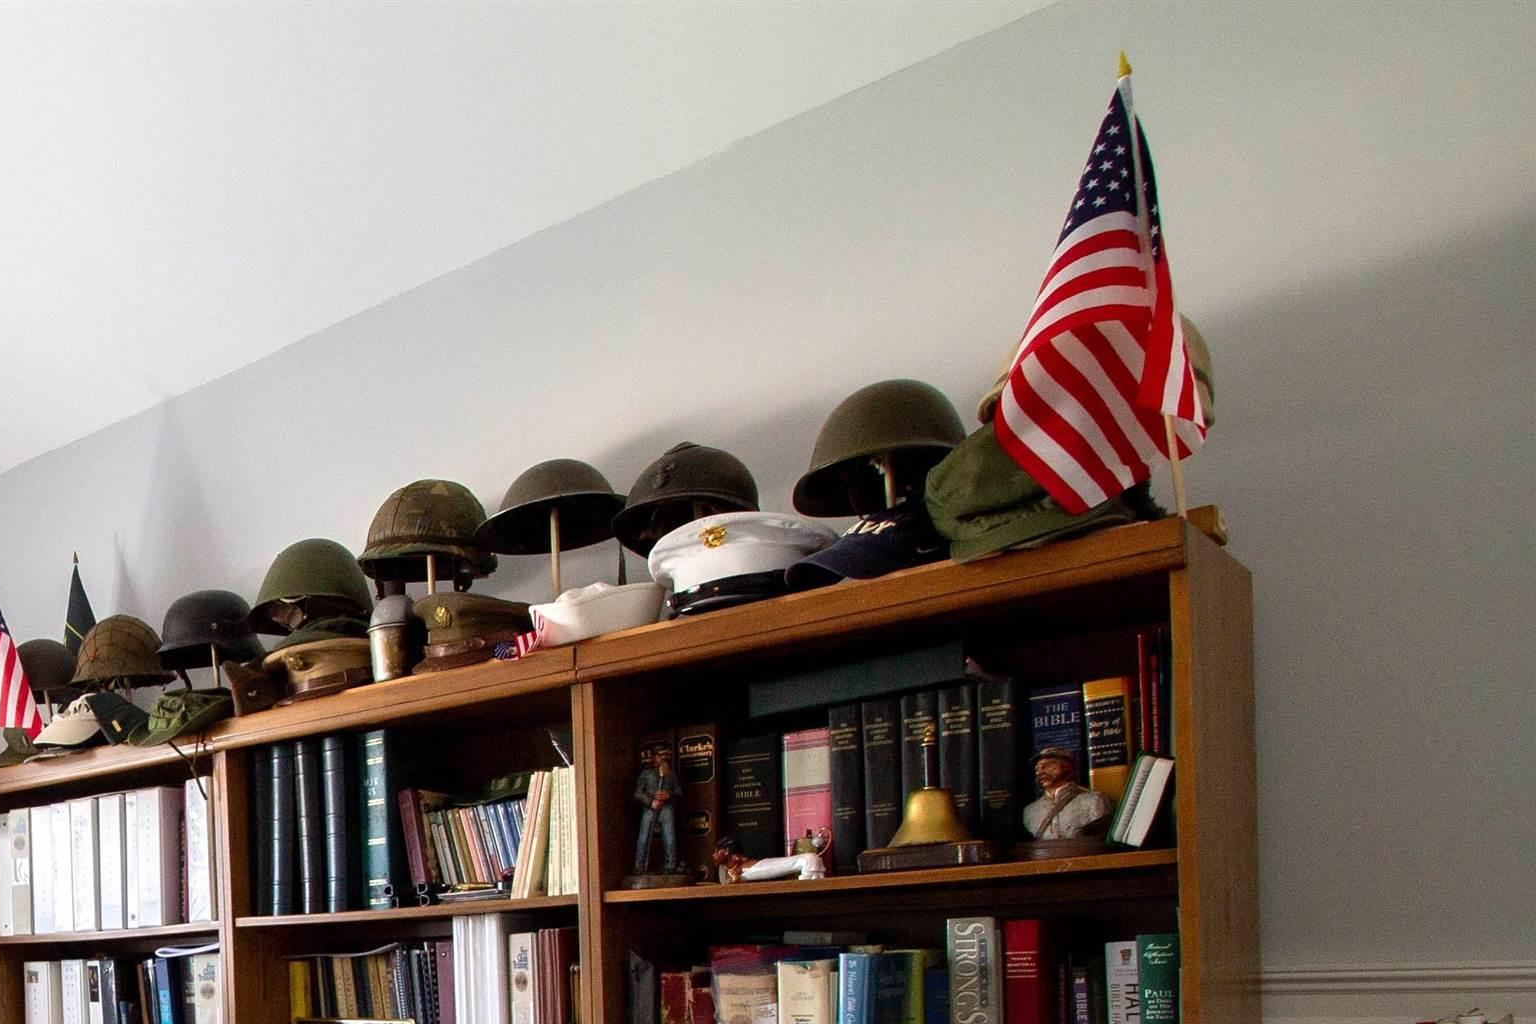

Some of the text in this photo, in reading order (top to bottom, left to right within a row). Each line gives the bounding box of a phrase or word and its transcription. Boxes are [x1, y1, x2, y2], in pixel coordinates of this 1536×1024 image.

[1044, 702, 1069, 714] THE
[1034, 711, 1081, 728] BIBLE
[735, 790, 761, 799] BIBLE
[954, 922, 987, 1024] STRONG'S
[1110, 983, 1121, 1009] BIBLE
[1144, 989, 1175, 999] PAUL
[1075, 992, 1088, 1021] BIBLE
